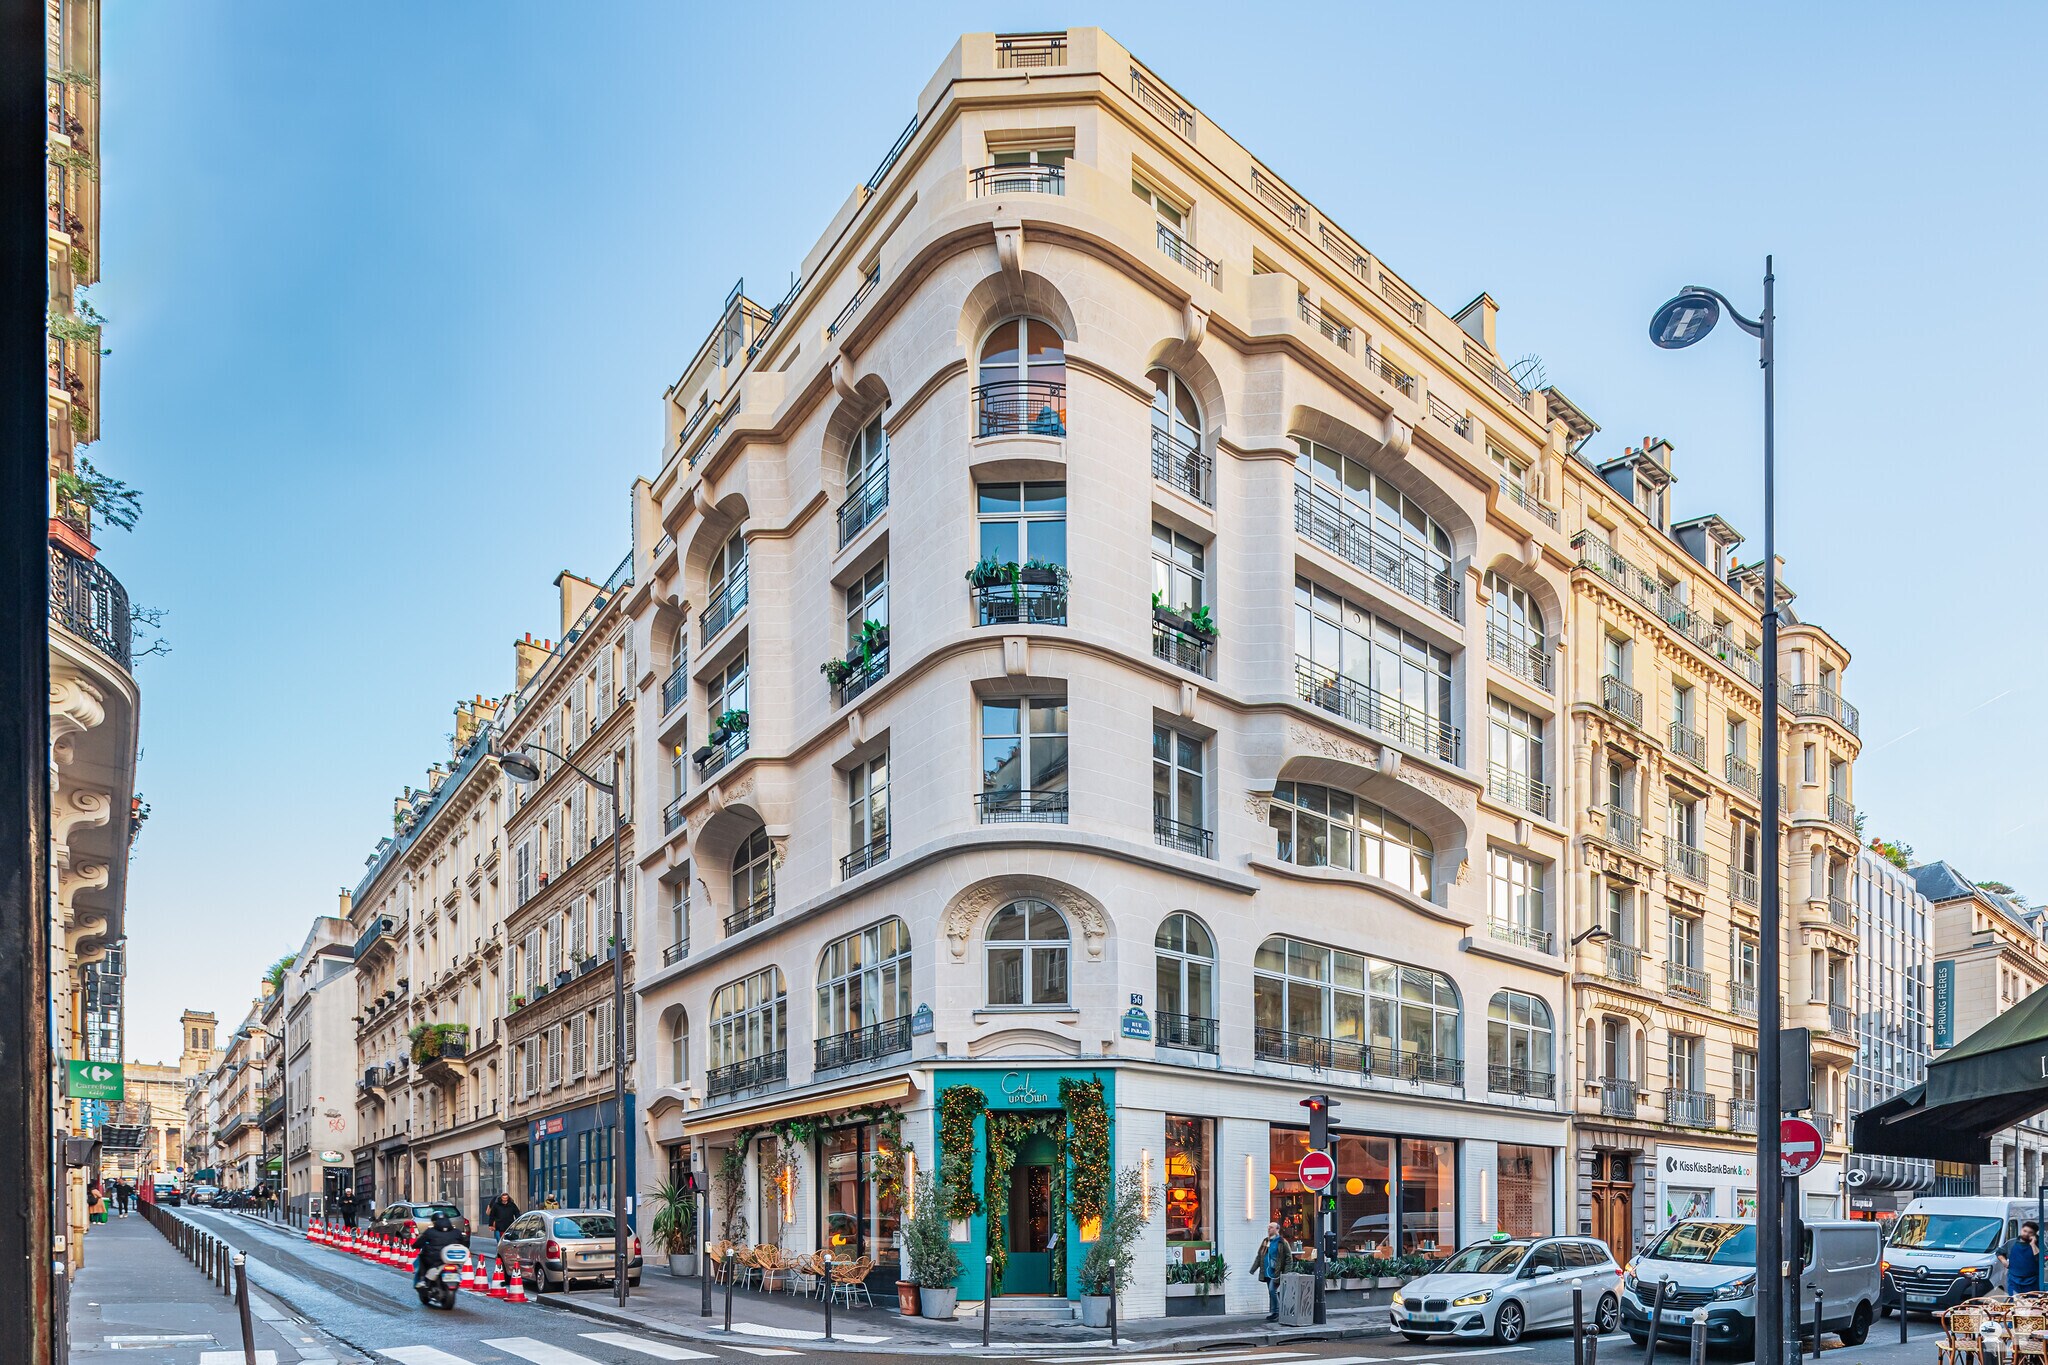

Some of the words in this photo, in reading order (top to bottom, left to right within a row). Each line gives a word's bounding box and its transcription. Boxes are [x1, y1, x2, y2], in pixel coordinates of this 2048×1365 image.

[1937, 967, 1948, 999] FRÈRES
[1132, 995, 1142, 1004] 36
[1938, 1000, 1947, 1035] SPRUNG
[75, 1082, 117, 1091] Carrefour
[1008, 1093, 1048, 1103] UPTOWN
[1679, 1160, 1738, 1176] KissKissBankBank
[1737, 1165, 1743, 1176] &
